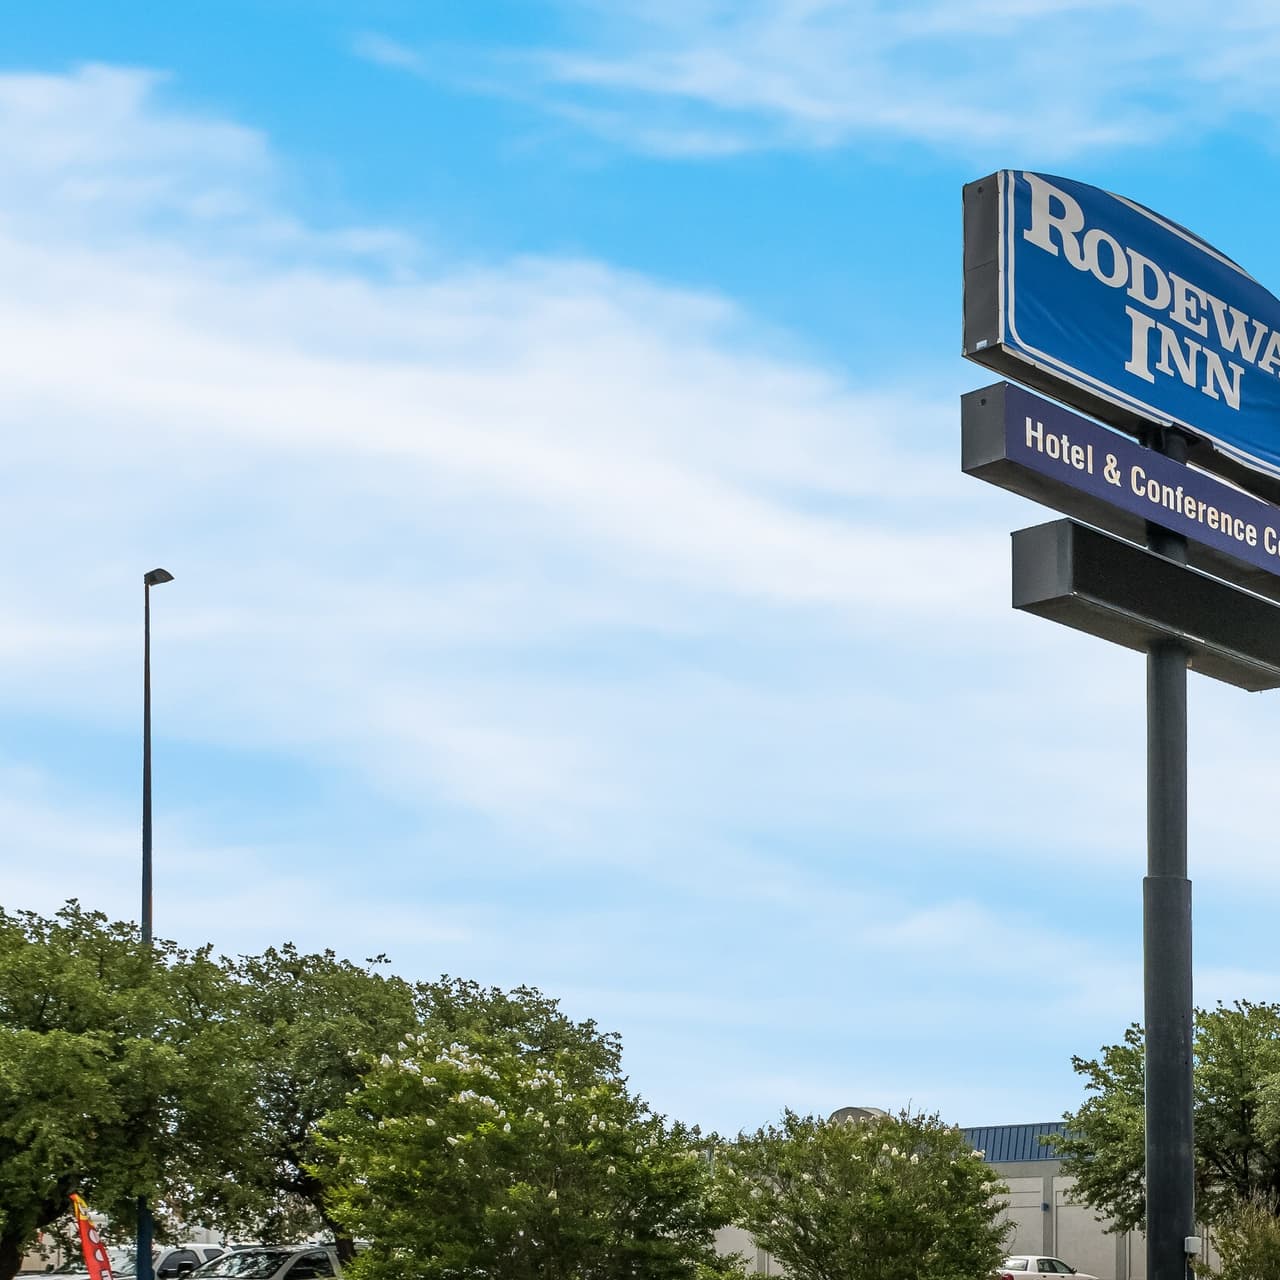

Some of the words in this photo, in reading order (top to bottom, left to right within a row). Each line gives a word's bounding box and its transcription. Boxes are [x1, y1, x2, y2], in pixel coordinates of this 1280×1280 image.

[1124, 304, 1245, 410] INN
[1024, 416, 1094, 474] Hotel
[1103, 452, 1123, 488] &
[1130, 465, 1258, 547] Conference
